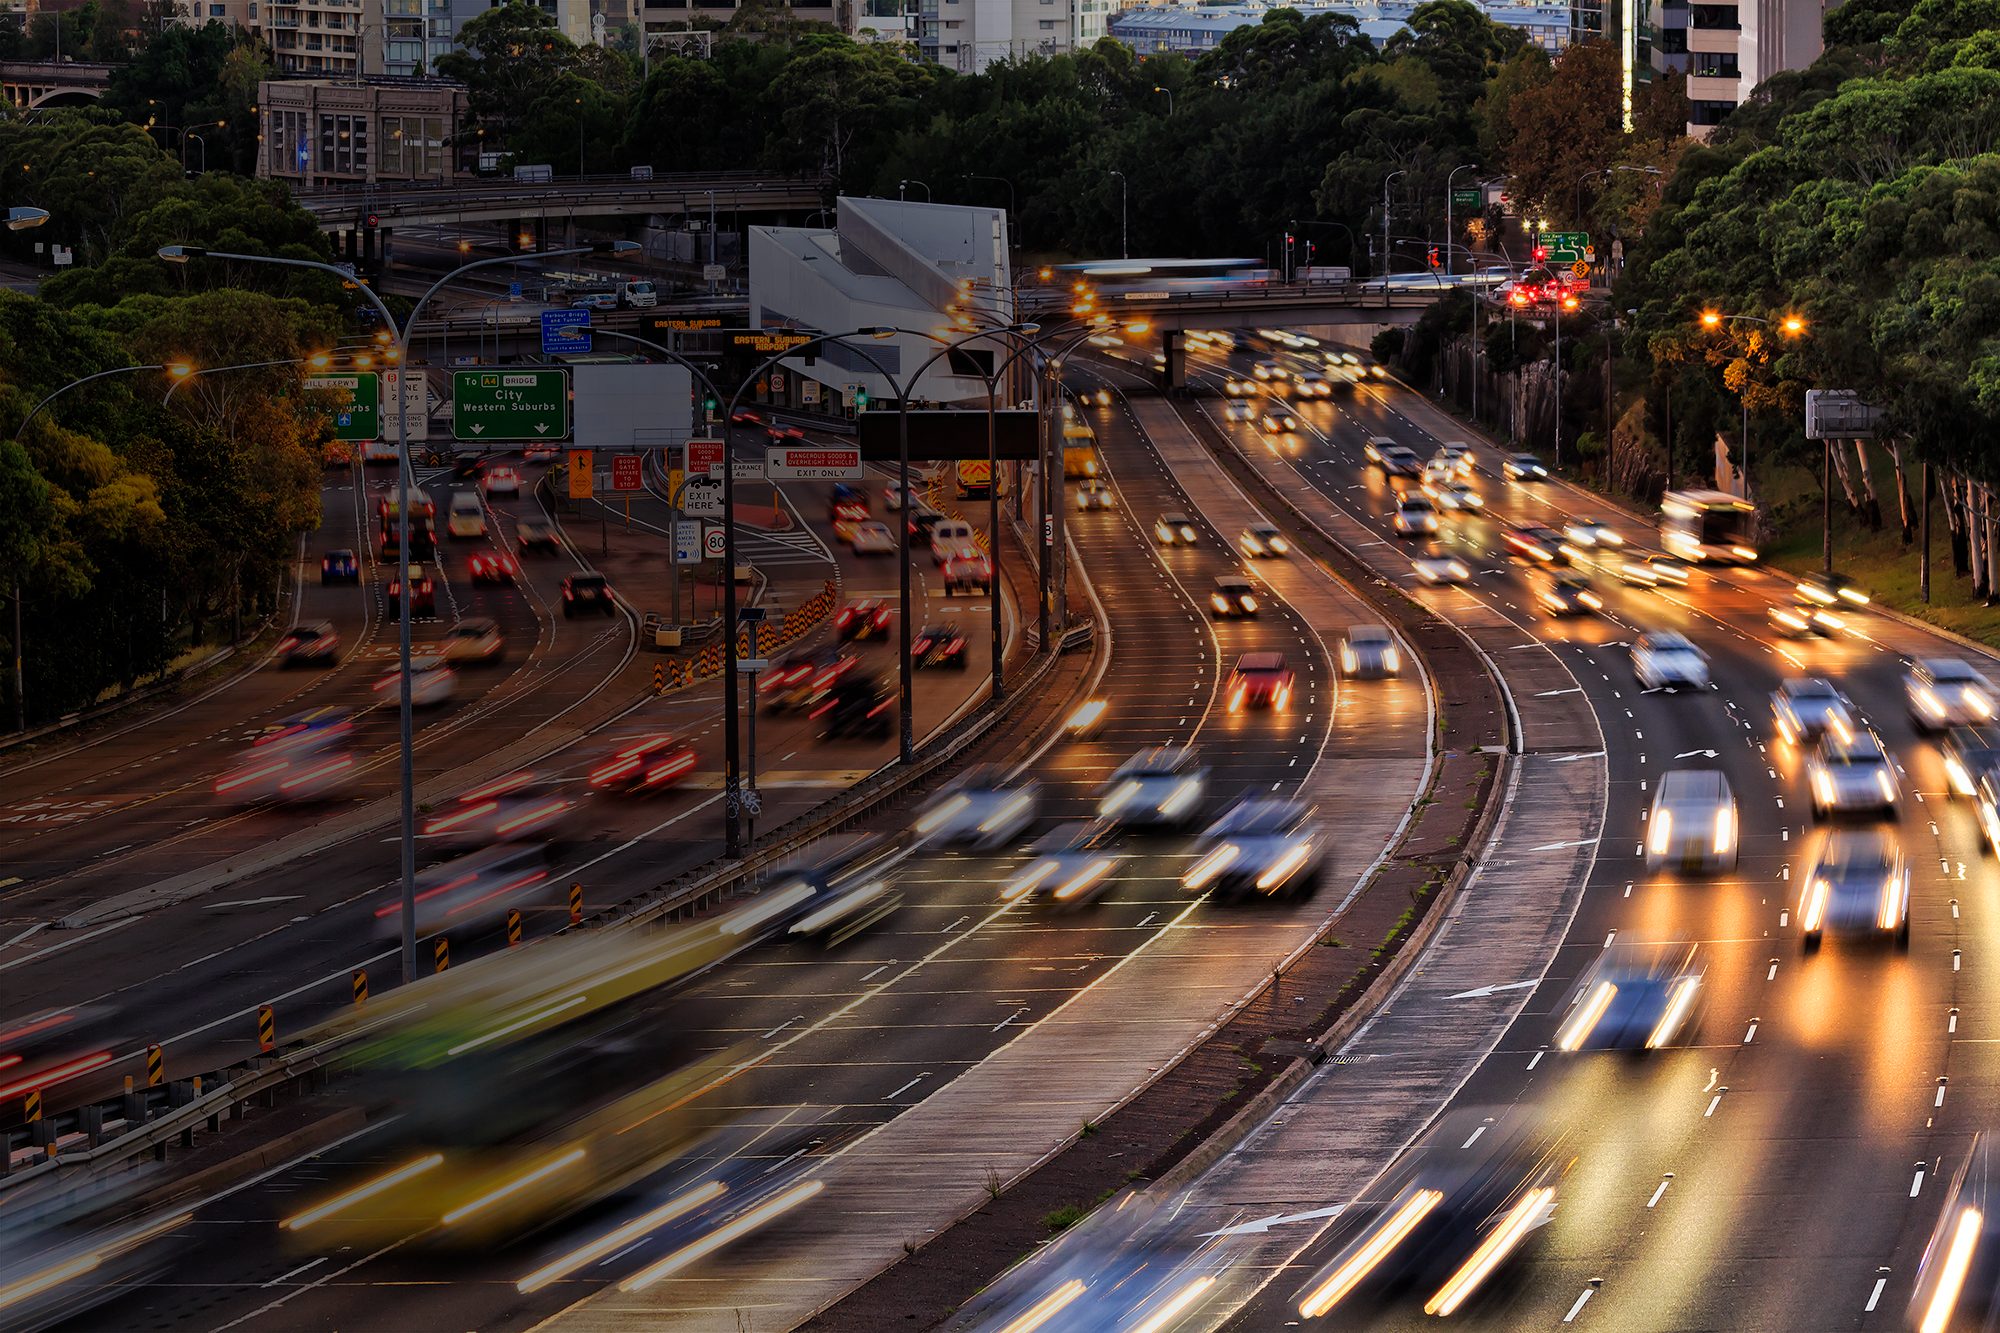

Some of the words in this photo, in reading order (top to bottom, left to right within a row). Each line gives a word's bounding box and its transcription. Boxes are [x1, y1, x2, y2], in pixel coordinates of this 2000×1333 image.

[655, 320, 687, 328] EASTERN
[689, 319, 721, 328] SUBURBS
[735, 336, 771, 344] EASTERN
[775, 335, 811, 344] SUBURBS
[327, 380, 355, 388] EXPWY
[465, 377, 477, 386] To
[484, 377, 497, 385] A4
[505, 377, 535, 385] BRIDGE
[495, 389, 523, 402] City
[463, 403, 506, 412] Western
[511, 402, 556, 412] Suburbs
[710, 537, 725, 548] 80
[14, 800, 114, 811] BUS
[0, 812, 91, 823] ANE
